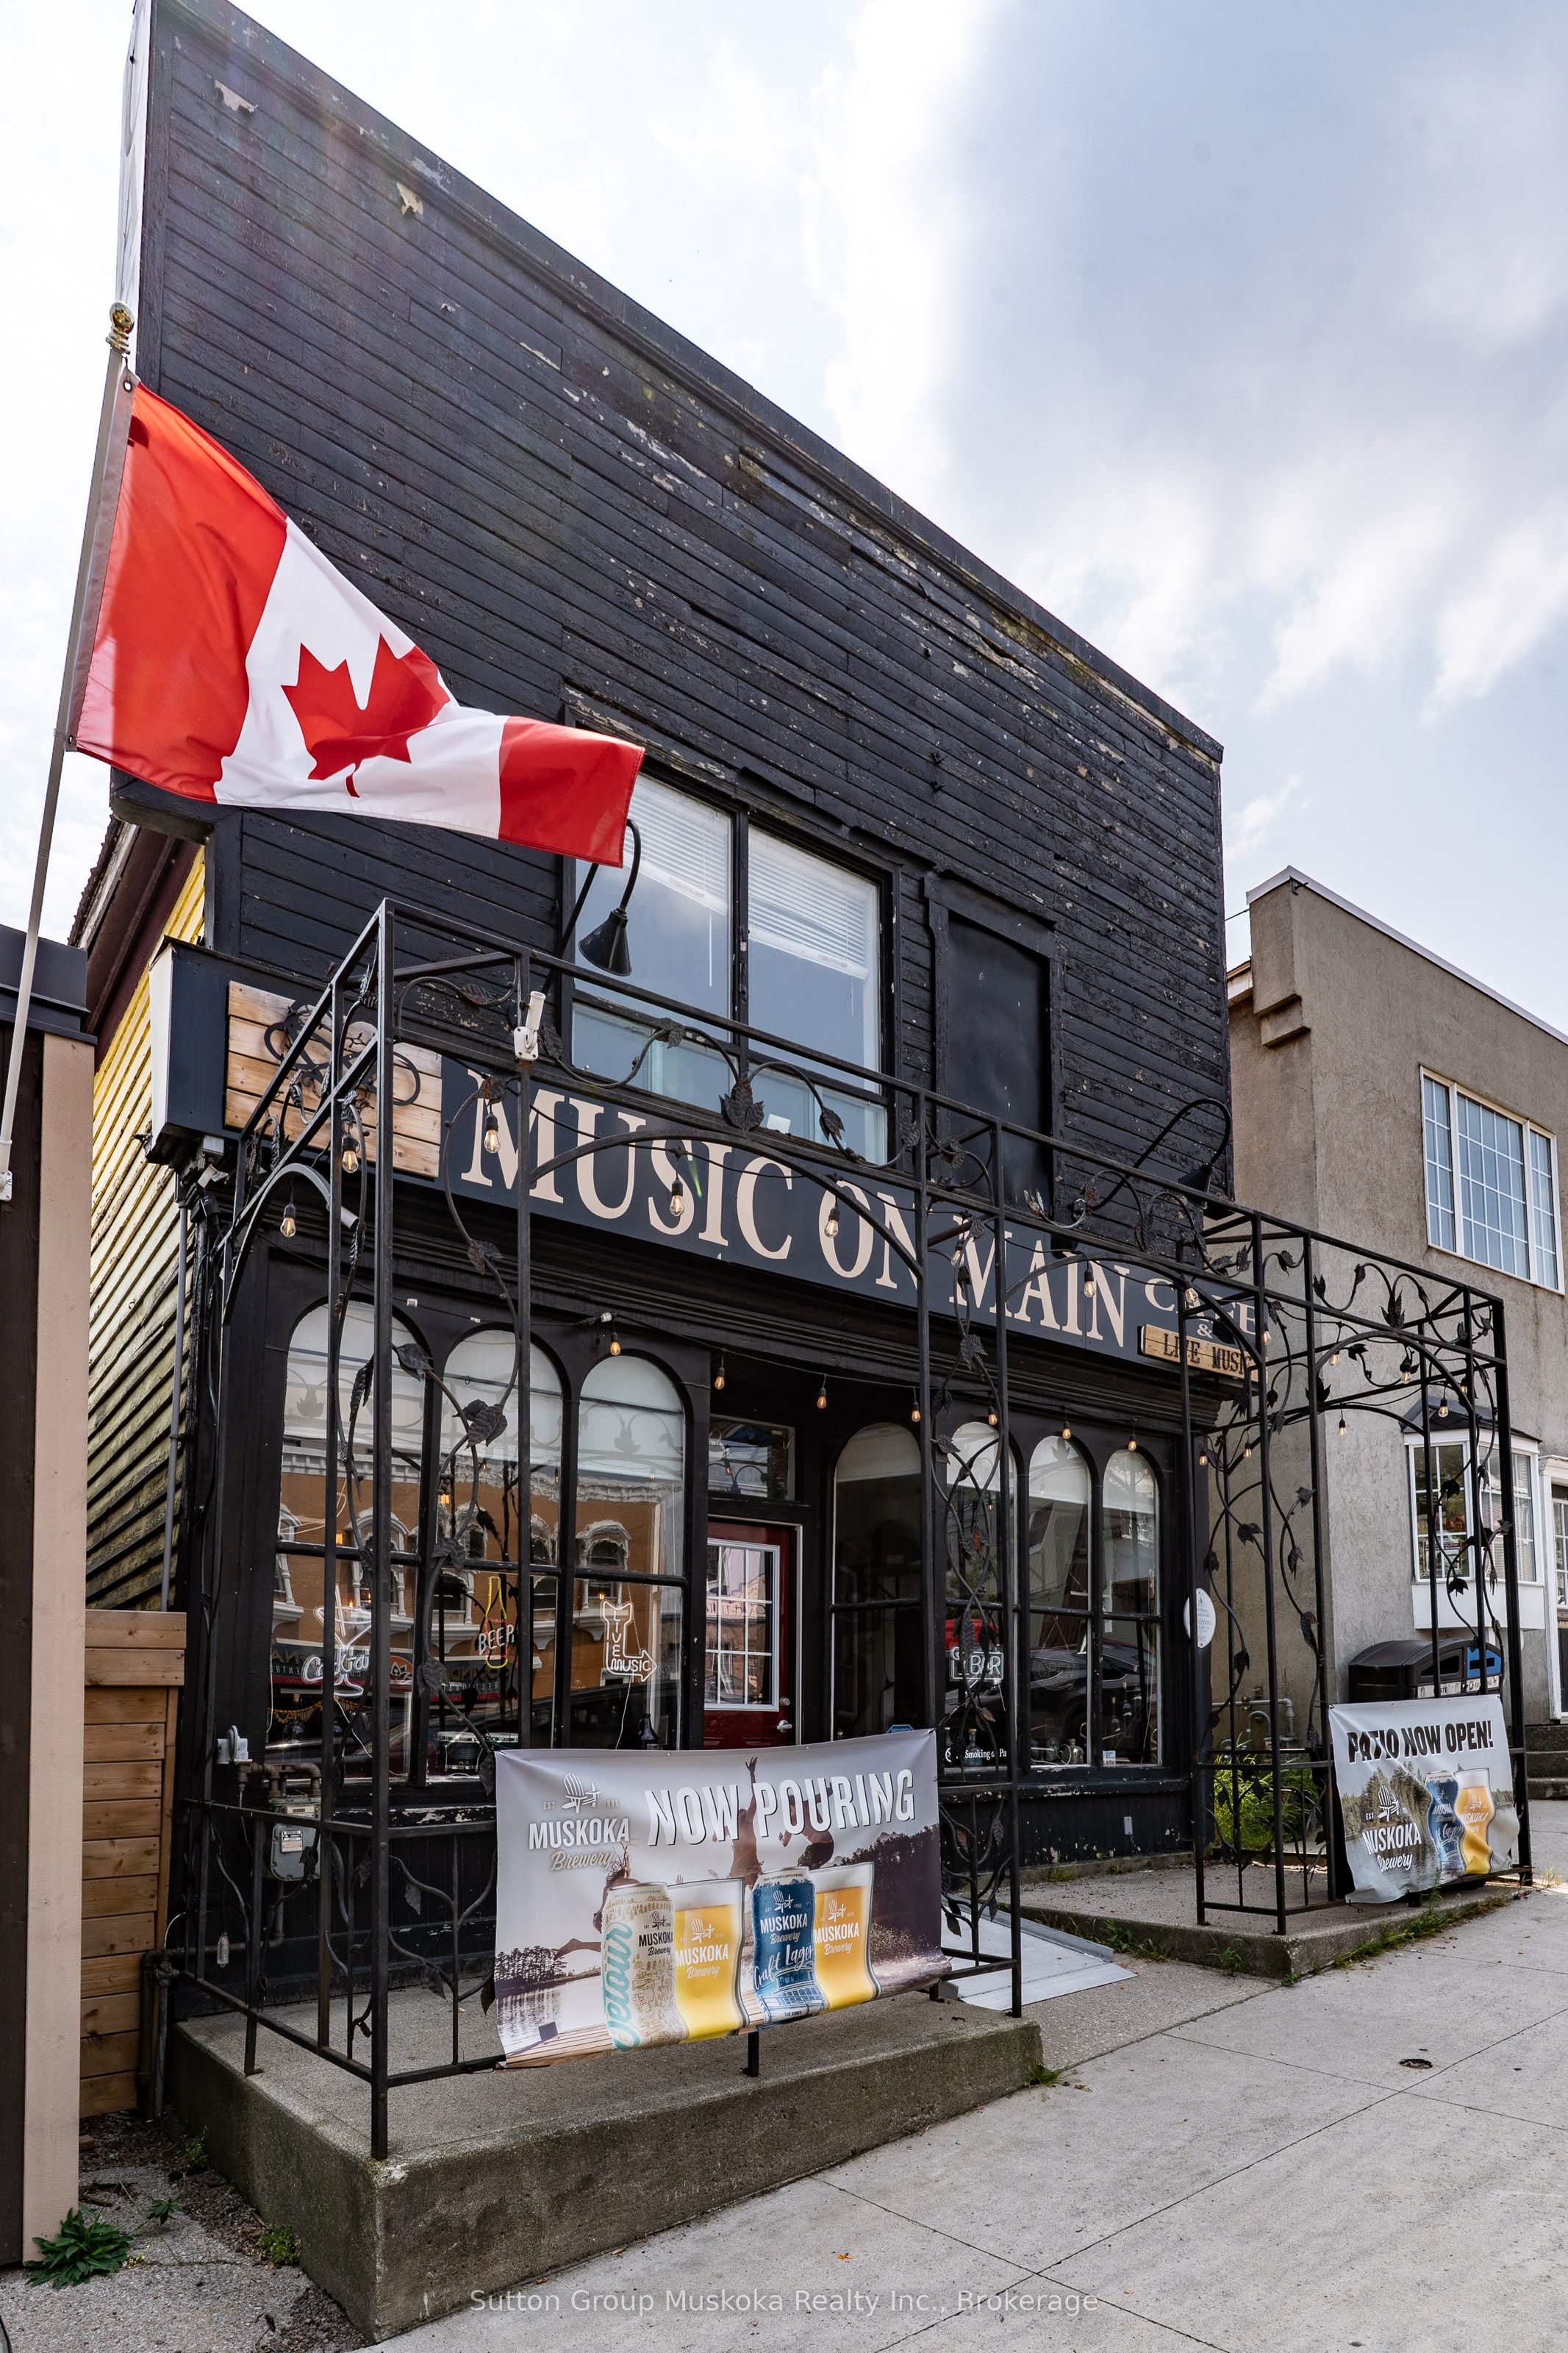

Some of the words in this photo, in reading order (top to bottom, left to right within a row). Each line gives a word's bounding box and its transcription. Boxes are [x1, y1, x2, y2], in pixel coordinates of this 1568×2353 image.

[460, 1068, 793, 1260] MUSIC
[818, 1179, 929, 1290] ON
[949, 1215, 1130, 1348] MAIN
[1164, 1333, 1200, 1364] LIE
[479, 1624, 515, 1655] BEER
[611, 1610, 622, 1657] LIVE
[610, 1658, 651, 1672] MUSIC
[1347, 1728, 1400, 1763] PATIO
[1401, 1724, 1442, 1757] NOW
[1445, 1720, 1494, 1754] OPEN!
[964, 1749, 991, 1760] Smoking
[543, 1802, 555, 1810] EST
[645, 1785, 739, 1846] NOW
[753, 1769, 915, 1838] POURING
[1366, 1812, 1374, 1821] EST
[529, 1817, 630, 1850] MUSKOKA
[1362, 1823, 1422, 1855] MUSKOKA
[550, 1850, 614, 1871] Brewery
[1377, 1853, 1413, 1872] Brewery
[760, 1913, 808, 1935] MUSKOKA
[815, 1921, 859, 1945] MUSKOKA
[770, 1932, 801, 1945] Brewery
[823, 1941, 853, 1956] Brewery
[648, 1946, 671, 1957] Brewery
[675, 1943, 729, 1967] MUSKOKA
[785, 1944, 816, 1971] Lager
[687, 1965, 720, 1980] Brewery
[754, 1953, 781, 1991] Craft
